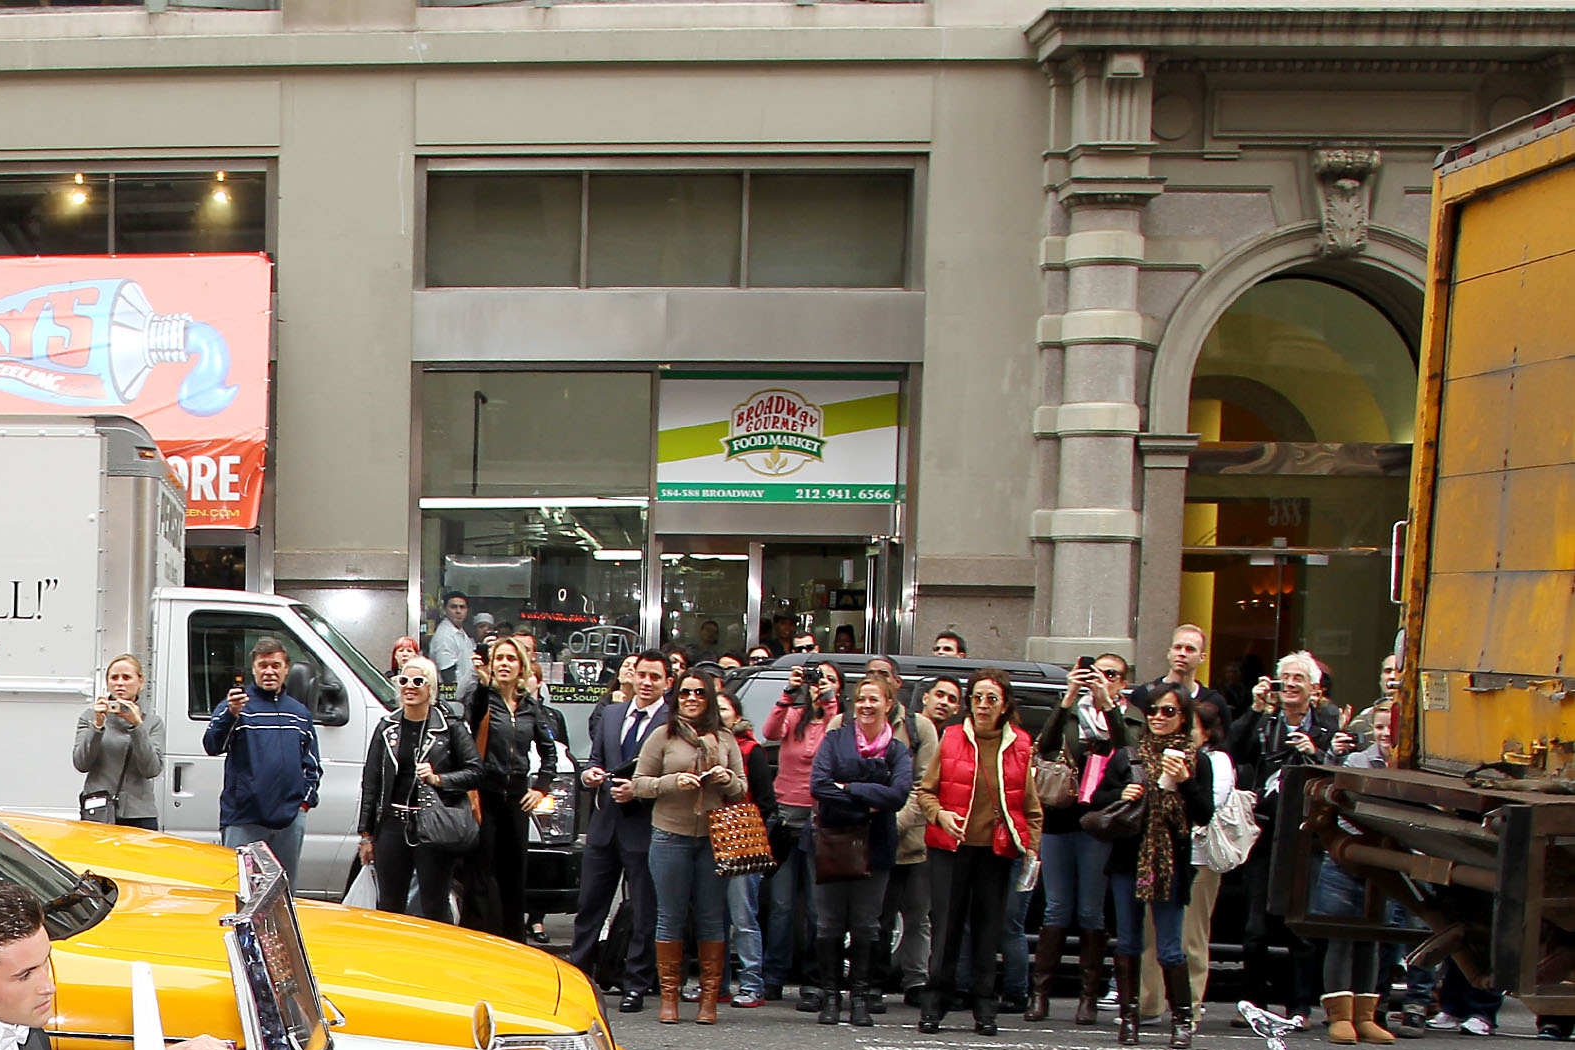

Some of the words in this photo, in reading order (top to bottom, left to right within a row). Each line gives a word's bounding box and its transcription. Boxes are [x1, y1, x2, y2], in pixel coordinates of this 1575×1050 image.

[736, 395, 818, 427] BROADWAY
[746, 416, 807, 433] GOURMET
[732, 435, 768, 451] FOOD
[769, 434, 820, 452] MARKET
[702, 488, 765, 498] BROADWAY
[795, 488, 892, 499] 212.941.6566
[568, 631, 638, 656] OPEN
[549, 685, 576, 693] Pizza
